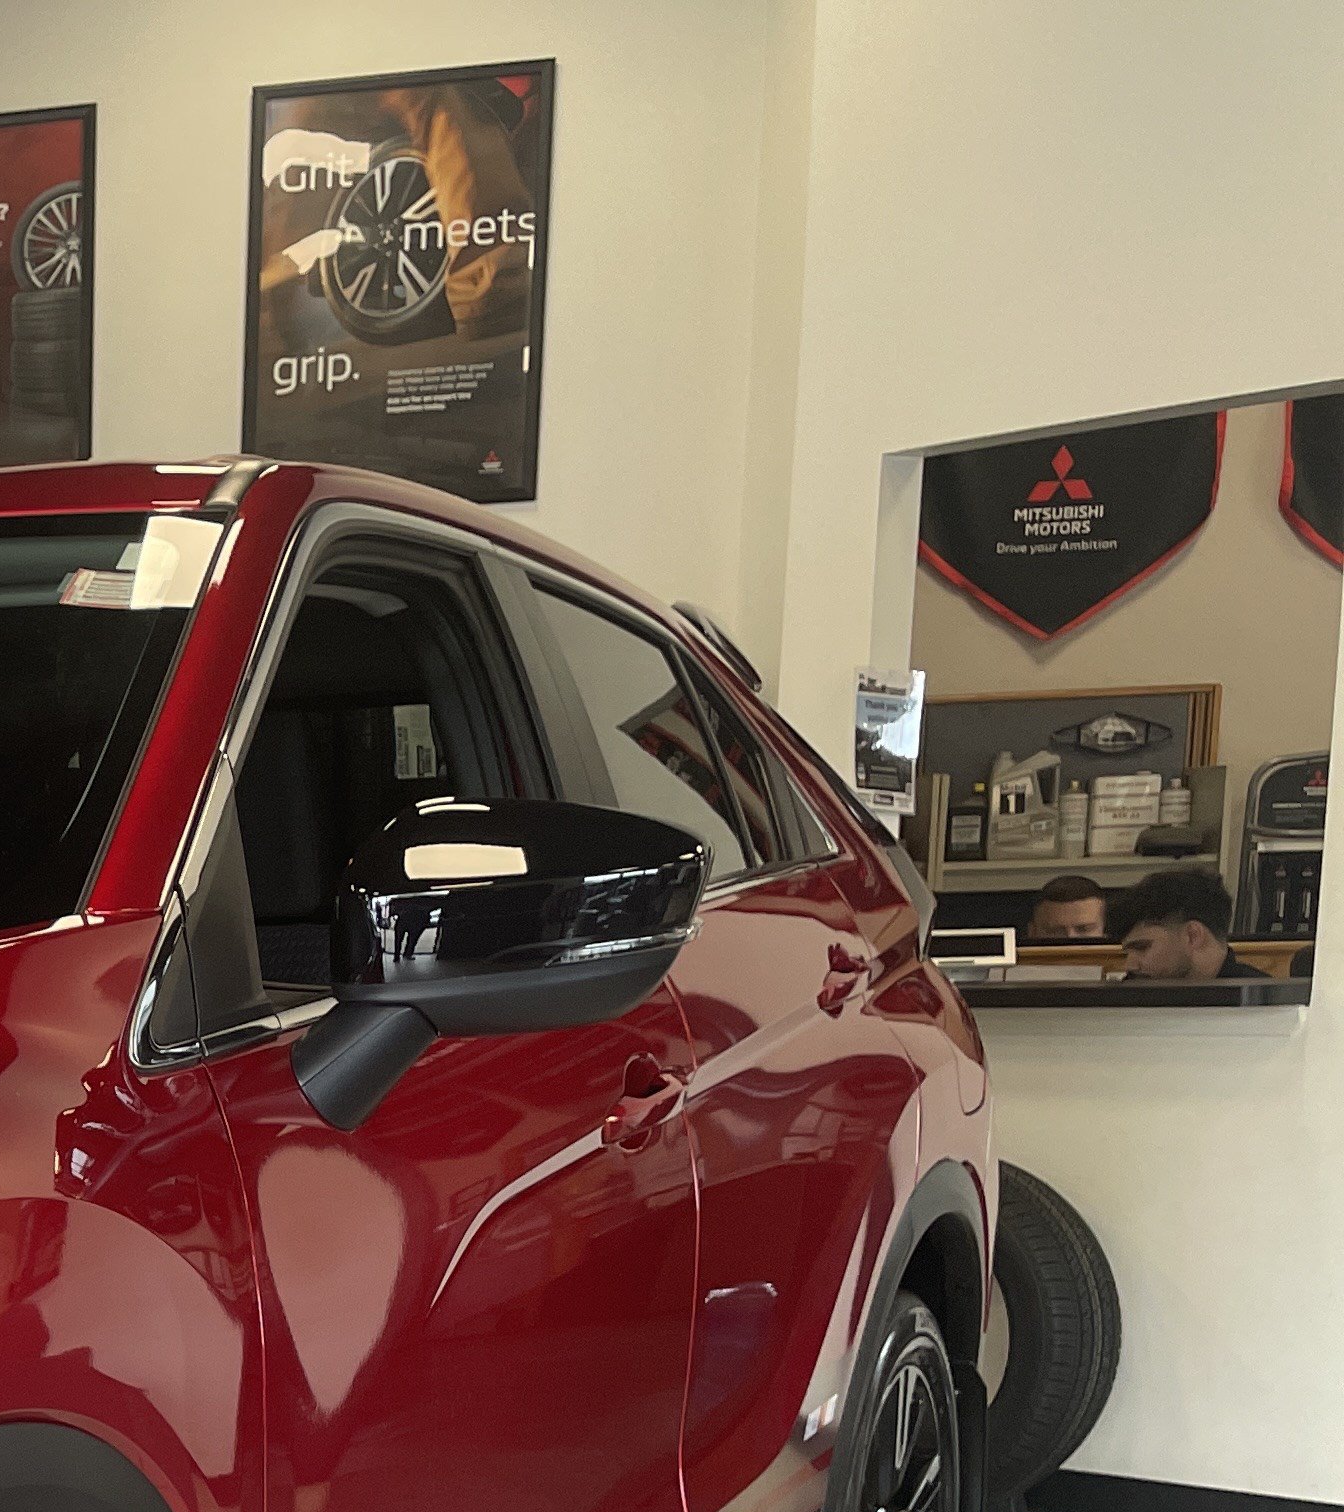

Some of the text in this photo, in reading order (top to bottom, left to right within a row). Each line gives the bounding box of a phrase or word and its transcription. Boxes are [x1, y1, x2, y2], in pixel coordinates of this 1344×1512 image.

[280, 152, 354, 193] Grit
[403, 208, 537, 251] meets
[272, 346, 361, 396] grip.
[1014, 505, 1104, 522] MITSUBISHI
[1024, 520, 1091, 536] MOTORS
[1030, 543, 1058, 555] your
[1060, 539, 1118, 552] Ambition
